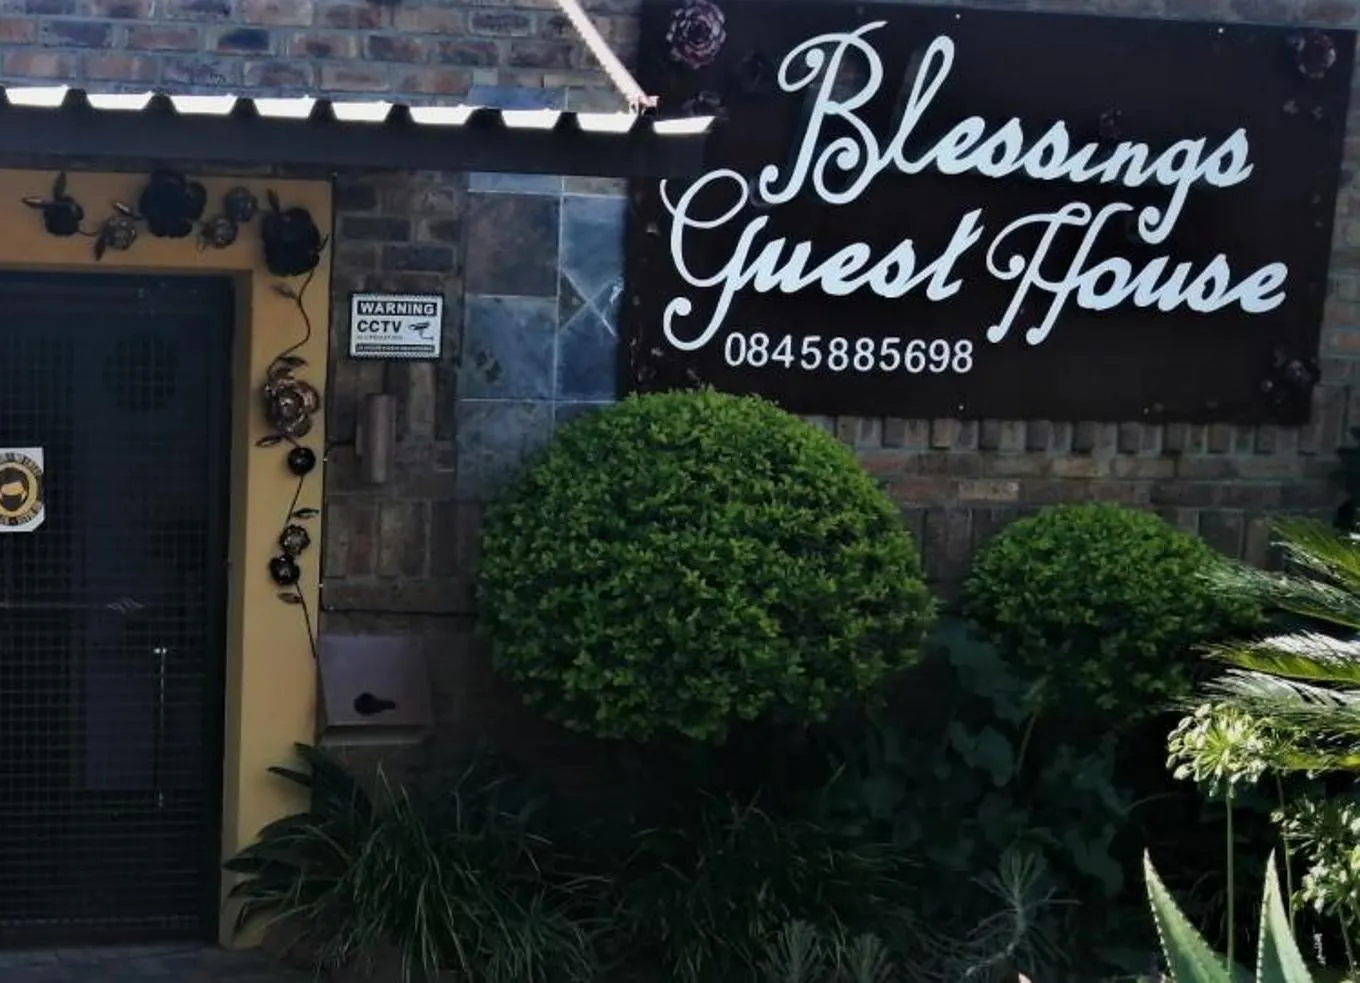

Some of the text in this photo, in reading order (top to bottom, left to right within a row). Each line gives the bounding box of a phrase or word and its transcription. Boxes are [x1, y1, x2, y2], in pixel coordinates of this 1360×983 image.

[758, 20, 1255, 244] Blessings
[659, 168, 1288, 351] Guest House
[357, 320, 402, 333] CCTV
[360, 302, 435, 315] WARNING
[724, 332, 974, 373] 0845885698
